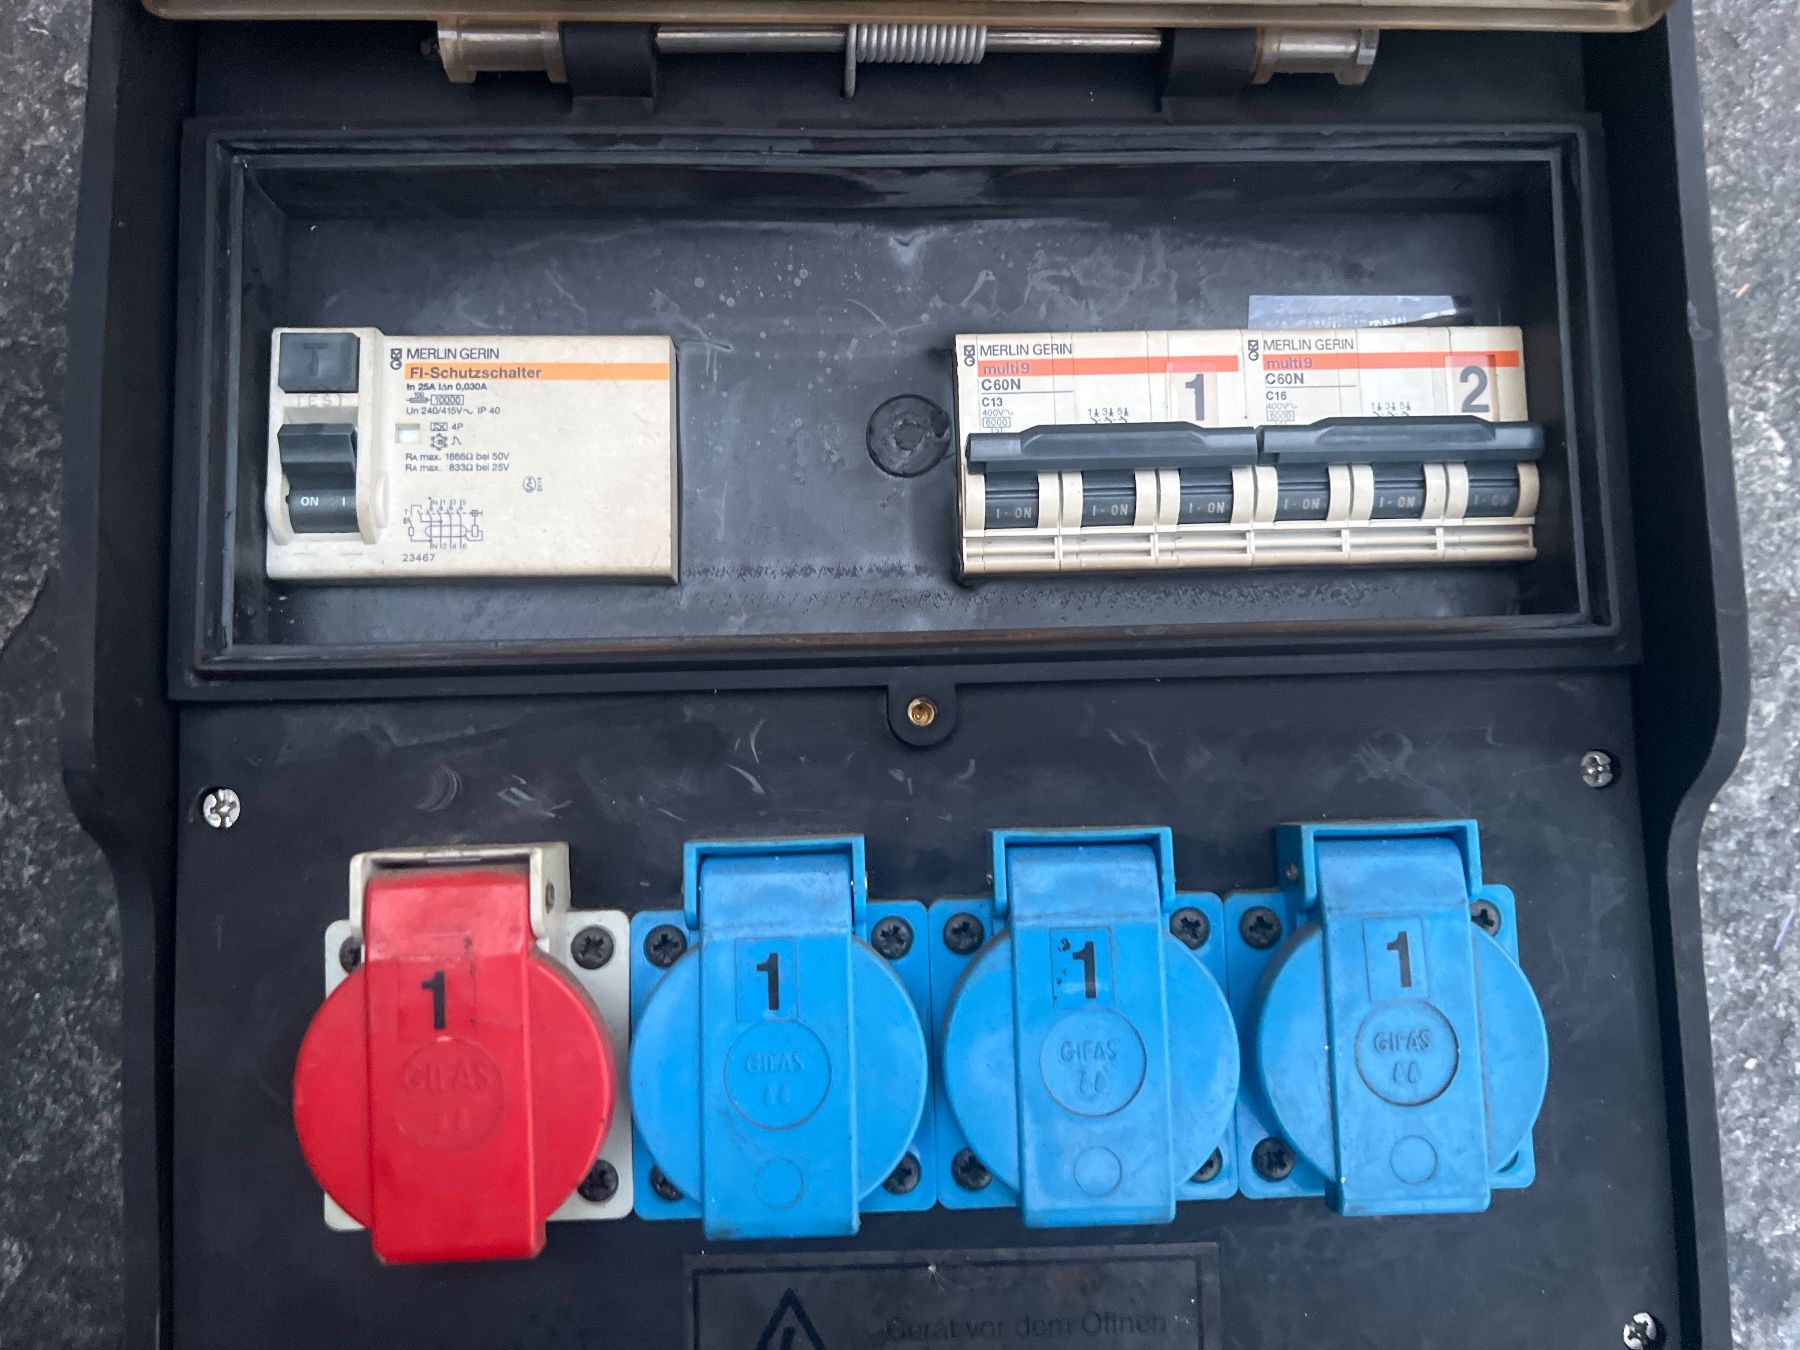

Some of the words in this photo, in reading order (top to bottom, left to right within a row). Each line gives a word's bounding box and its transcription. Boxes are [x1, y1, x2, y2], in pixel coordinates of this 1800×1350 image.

[980, 345, 1029, 357] MERLIN
[1033, 344, 1072, 355] GERIN
[1263, 339, 1312, 351] MERLIN
[1315, 338, 1354, 350] GERIN
[407, 348, 457, 359] MERLIN
[460, 348, 499, 359] GERIN
[410, 367, 541, 379] FI-Schutzschalter
[1265, 373, 1304, 385] C60N
[981, 378, 1021, 391] C60N
[1459, 365, 1490, 413] 2
[981, 397, 1003, 407] C13
[1185, 373, 1205, 421] 1
[1266, 391, 1287, 401] C16
[301, 496, 319, 506] ON
[402, 554, 435, 562] 23467
[1386, 931, 1411, 987] 1
[1072, 941, 1097, 999] 1
[756, 953, 780, 1010] 1
[421, 971, 446, 1029] 1
[1060, 1040, 1118, 1061] GIFAS
